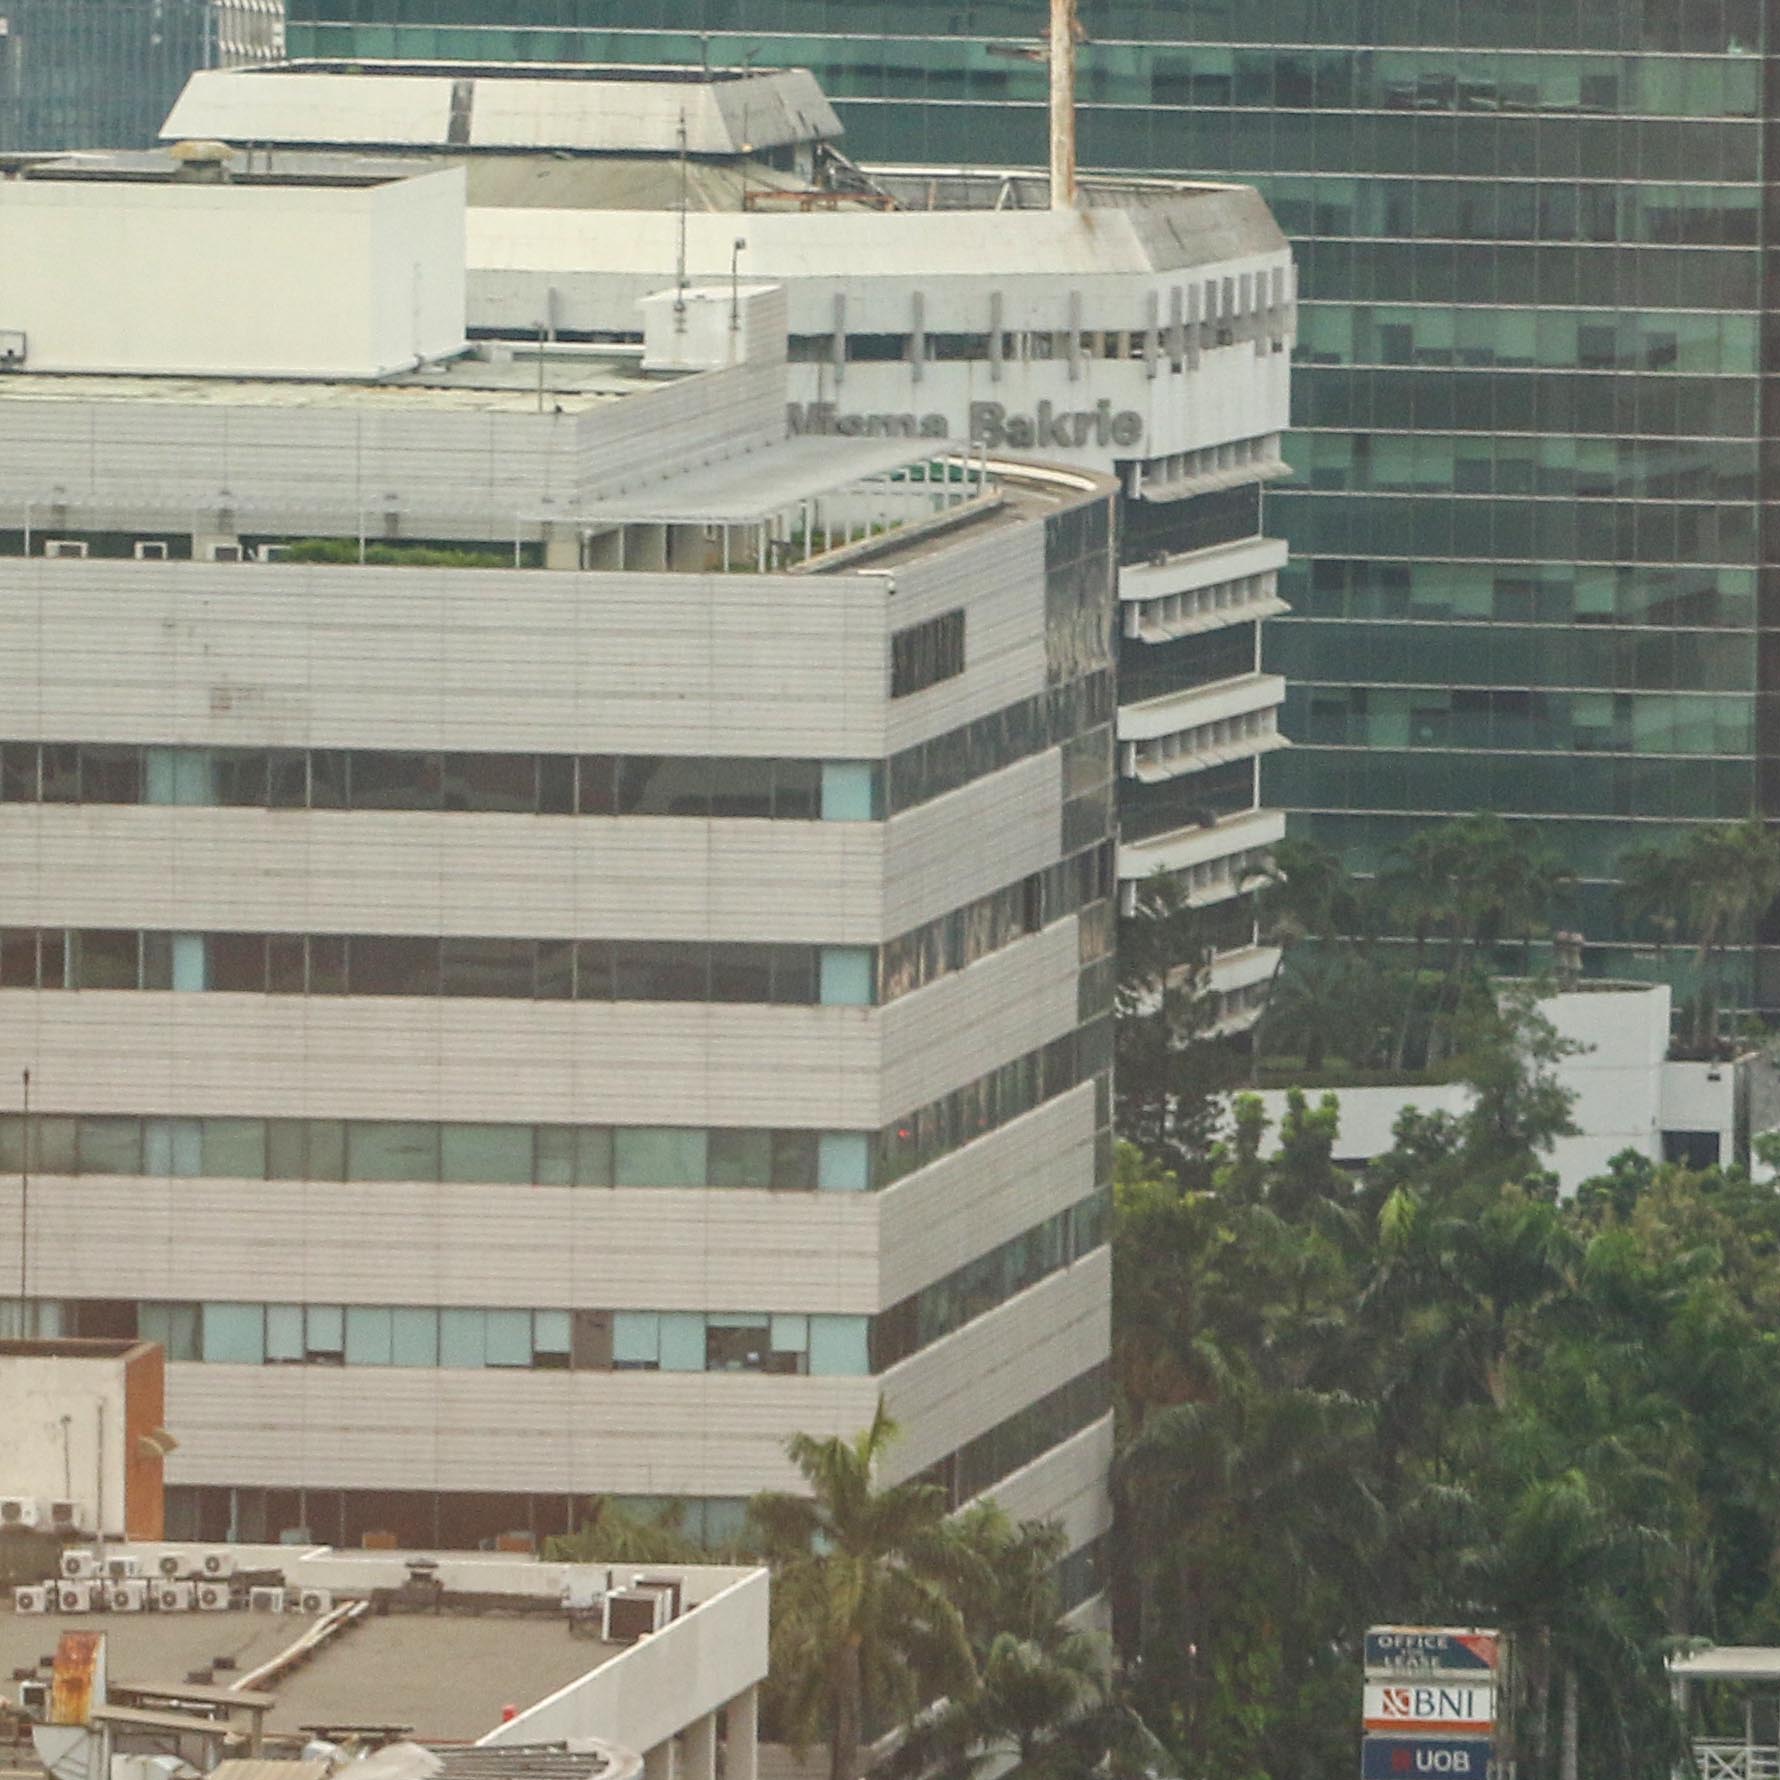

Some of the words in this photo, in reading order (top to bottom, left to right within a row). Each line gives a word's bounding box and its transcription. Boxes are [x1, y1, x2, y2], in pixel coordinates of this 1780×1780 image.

[786, 402, 948, 438] Wisma
[969, 399, 1143, 447] Bakrie
[1378, 1636, 1448, 1649] OFFICE
[1415, 1689, 1473, 1718] BNI
[1416, 1749, 1470, 1773] UOB
